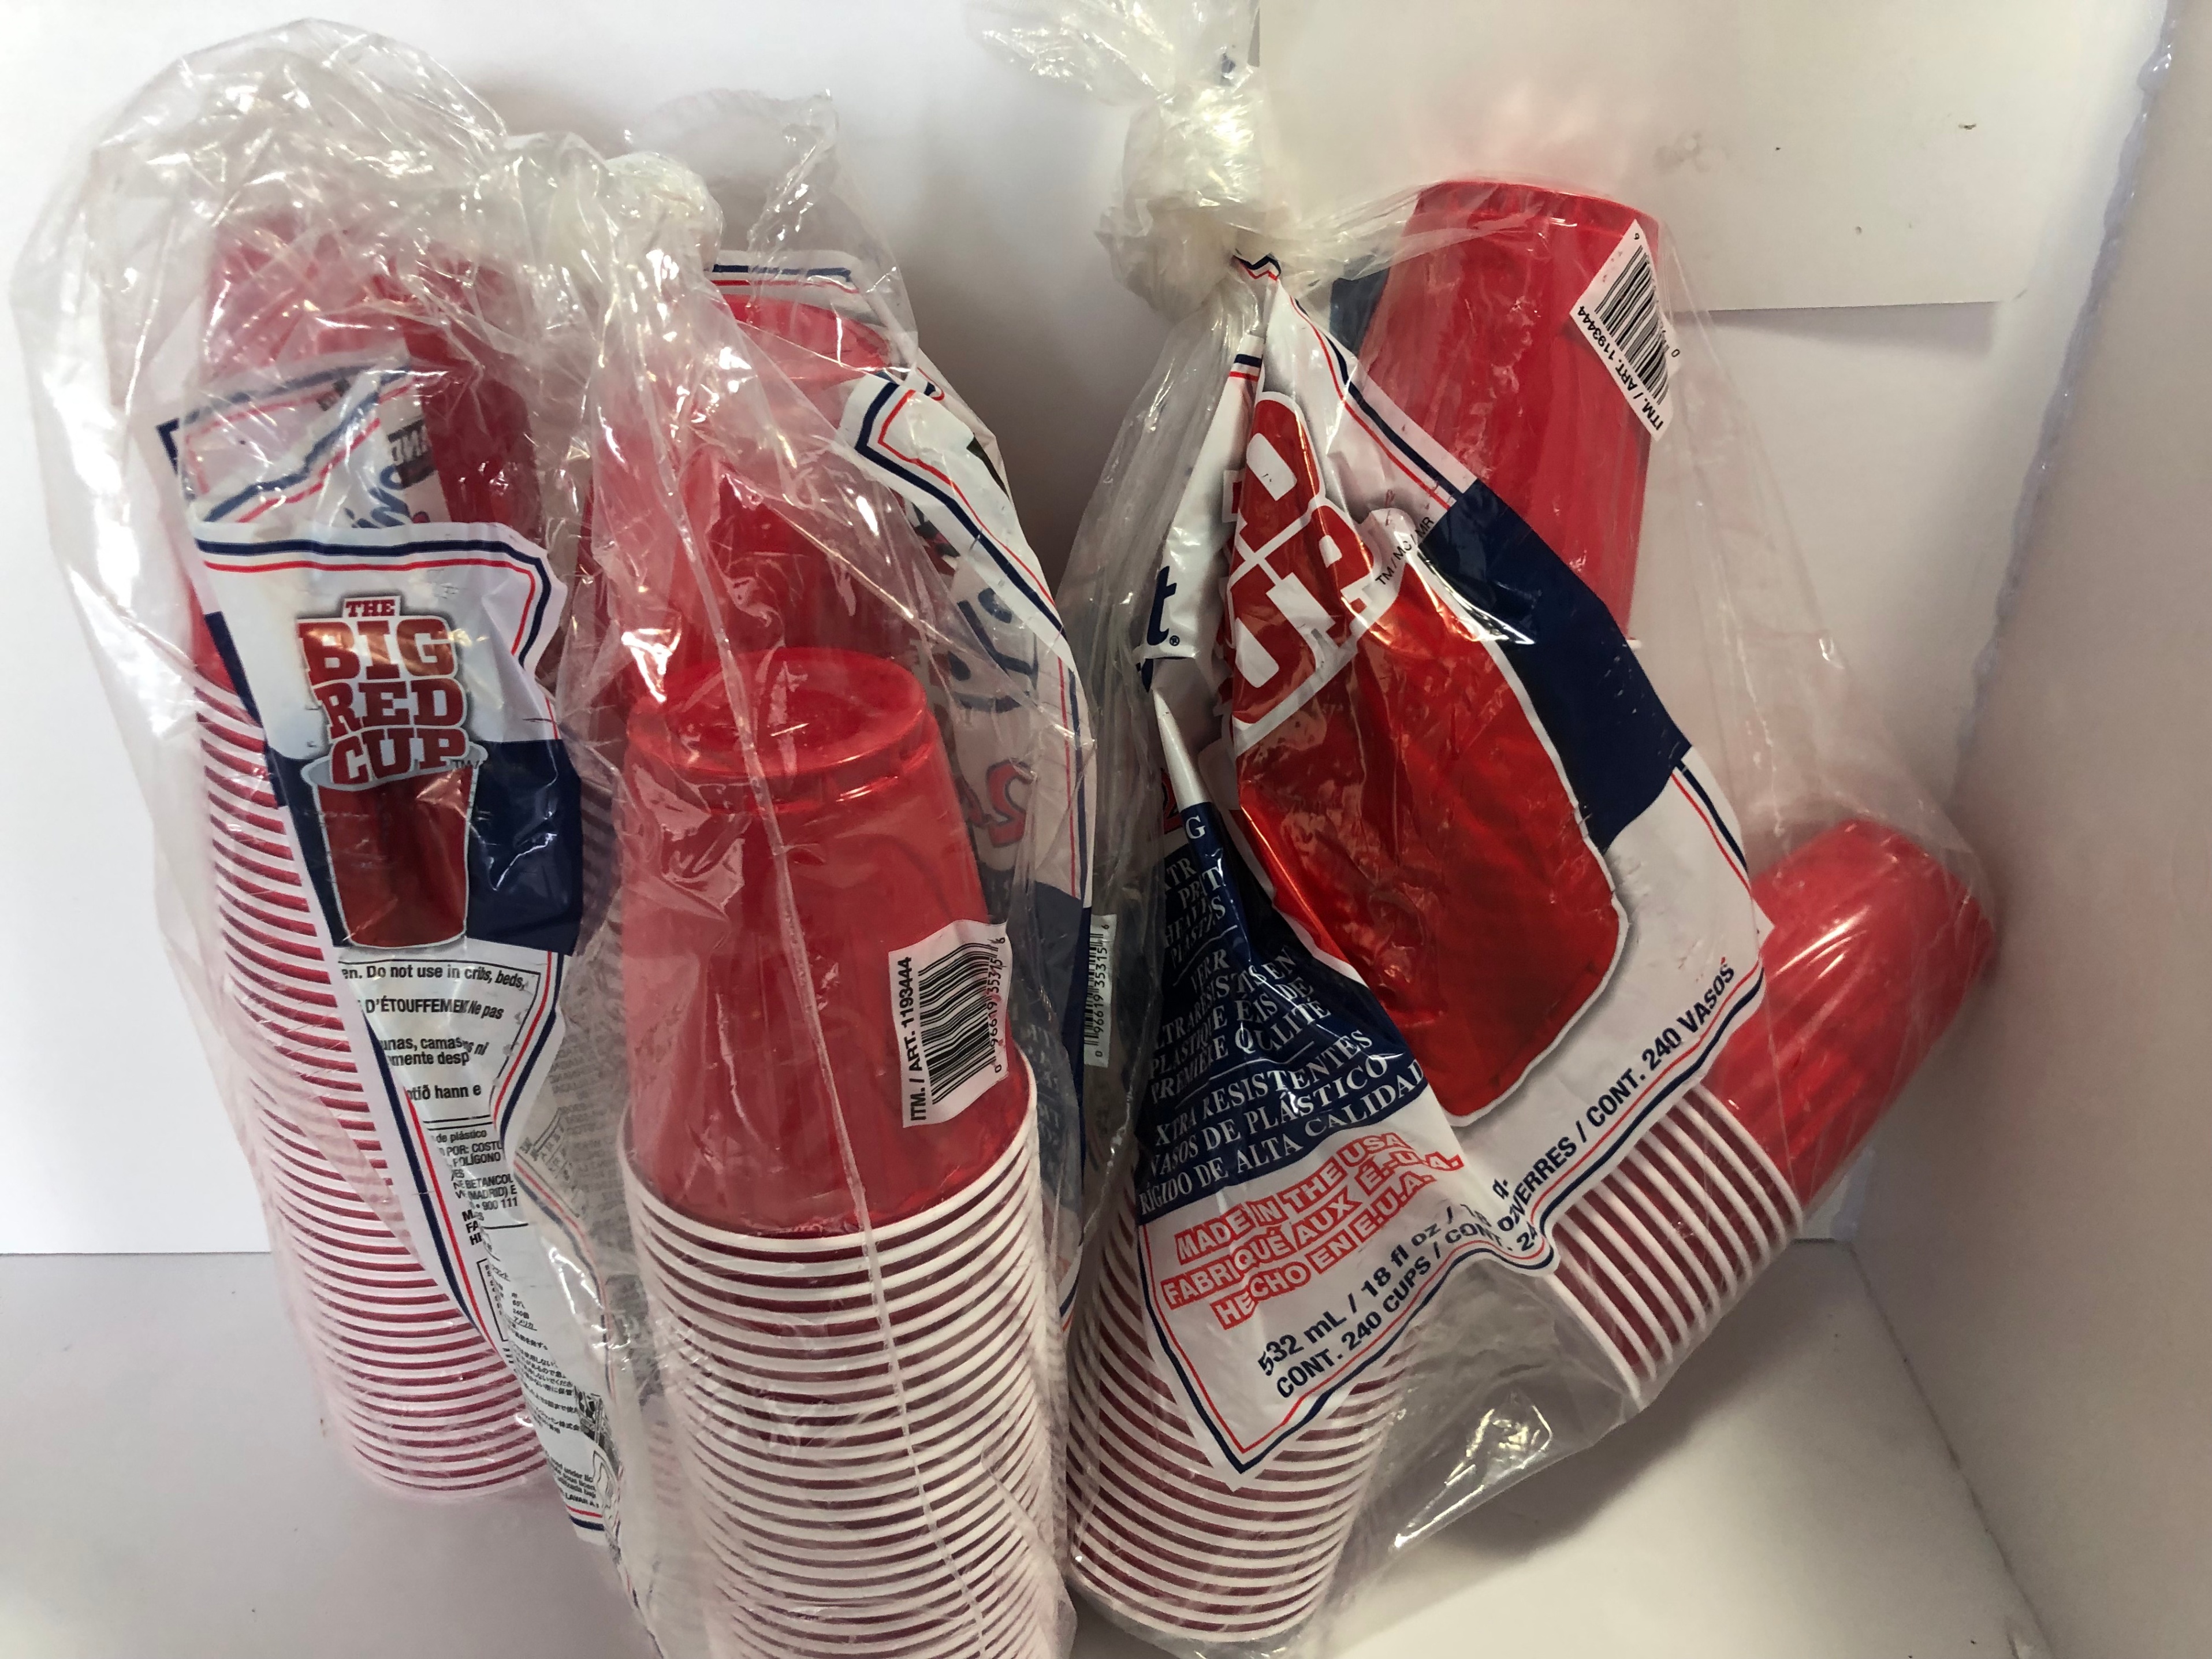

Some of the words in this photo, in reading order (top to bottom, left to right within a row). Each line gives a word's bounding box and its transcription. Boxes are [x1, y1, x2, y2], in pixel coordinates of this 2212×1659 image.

[1577, 306, 1616, 361] 1193444
[1615, 359, 1638, 391] ART.
[1375, 566, 1395, 586] TM
[1415, 516, 1435, 538] MR
[347, 598, 396, 618] THE
[298, 619, 456, 686] BIG
[313, 678, 464, 740] RED
[330, 727, 469, 786] CUP
[366, 965, 387, 979] Do
[390, 964, 414, 979] not
[416, 966, 444, 979] use
[447, 964, 460, 979] in
[494, 970, 526, 991] beds,
[898, 957, 915, 1028] 1193444
[986, 957, 1004, 996] 35315
[1094, 946, 1108, 989] 35315
[481, 1005, 505, 1020] pas
[1092, 994, 1105, 1035] 96619
[904, 1031, 923, 1072] ART.
[1202, 1029, 1373, 1120] RESISTENTES
[434, 1084, 469, 1099] hann
[910, 1087, 927, 1121] ITM.
[1201, 1118, 1242, 1152] DE
[1243, 1054, 1388, 1136] PLÁSTICO
[435, 1133, 448, 1144] de
[1193, 1156, 1230, 1188] DE
[1235, 1133, 1305, 1174] ALTA
[1304, 1059, 1424, 1137] CALIDAD
[1175, 1206, 1250, 1262] MADE
[1249, 1203, 1283, 1225] IN
[1282, 1161, 1343, 1211] THE
[1340, 1134, 1406, 1163] USA
[1276, 1348, 1343, 1398] CONT.
[1340, 1311, 1382, 1351] 240
[1382, 1256, 1431, 1313] CUPS
[1512, 1136, 1578, 1217] VERRES
[1585, 1067, 1647, 1128] CONT.
[1641, 1026, 1682, 1070] 240
[1675, 962, 1736, 1034] VASOS
[1162, 1230, 1291, 1305] FABRIQUÉ
[1294, 1192, 1355, 1245] AUX
[1214, 1265, 1308, 1326] HECHO
[1309, 1233, 1353, 1270] EN
[1353, 1174, 1432, 1240] E.U.A.
[1257, 1334, 1305, 1377] 532
[1303, 1311, 1348, 1344] mL
[1360, 1266, 1391, 1297] 18
[1390, 1244, 1410, 1268] fl
[1410, 1223, 1442, 1247] oz
